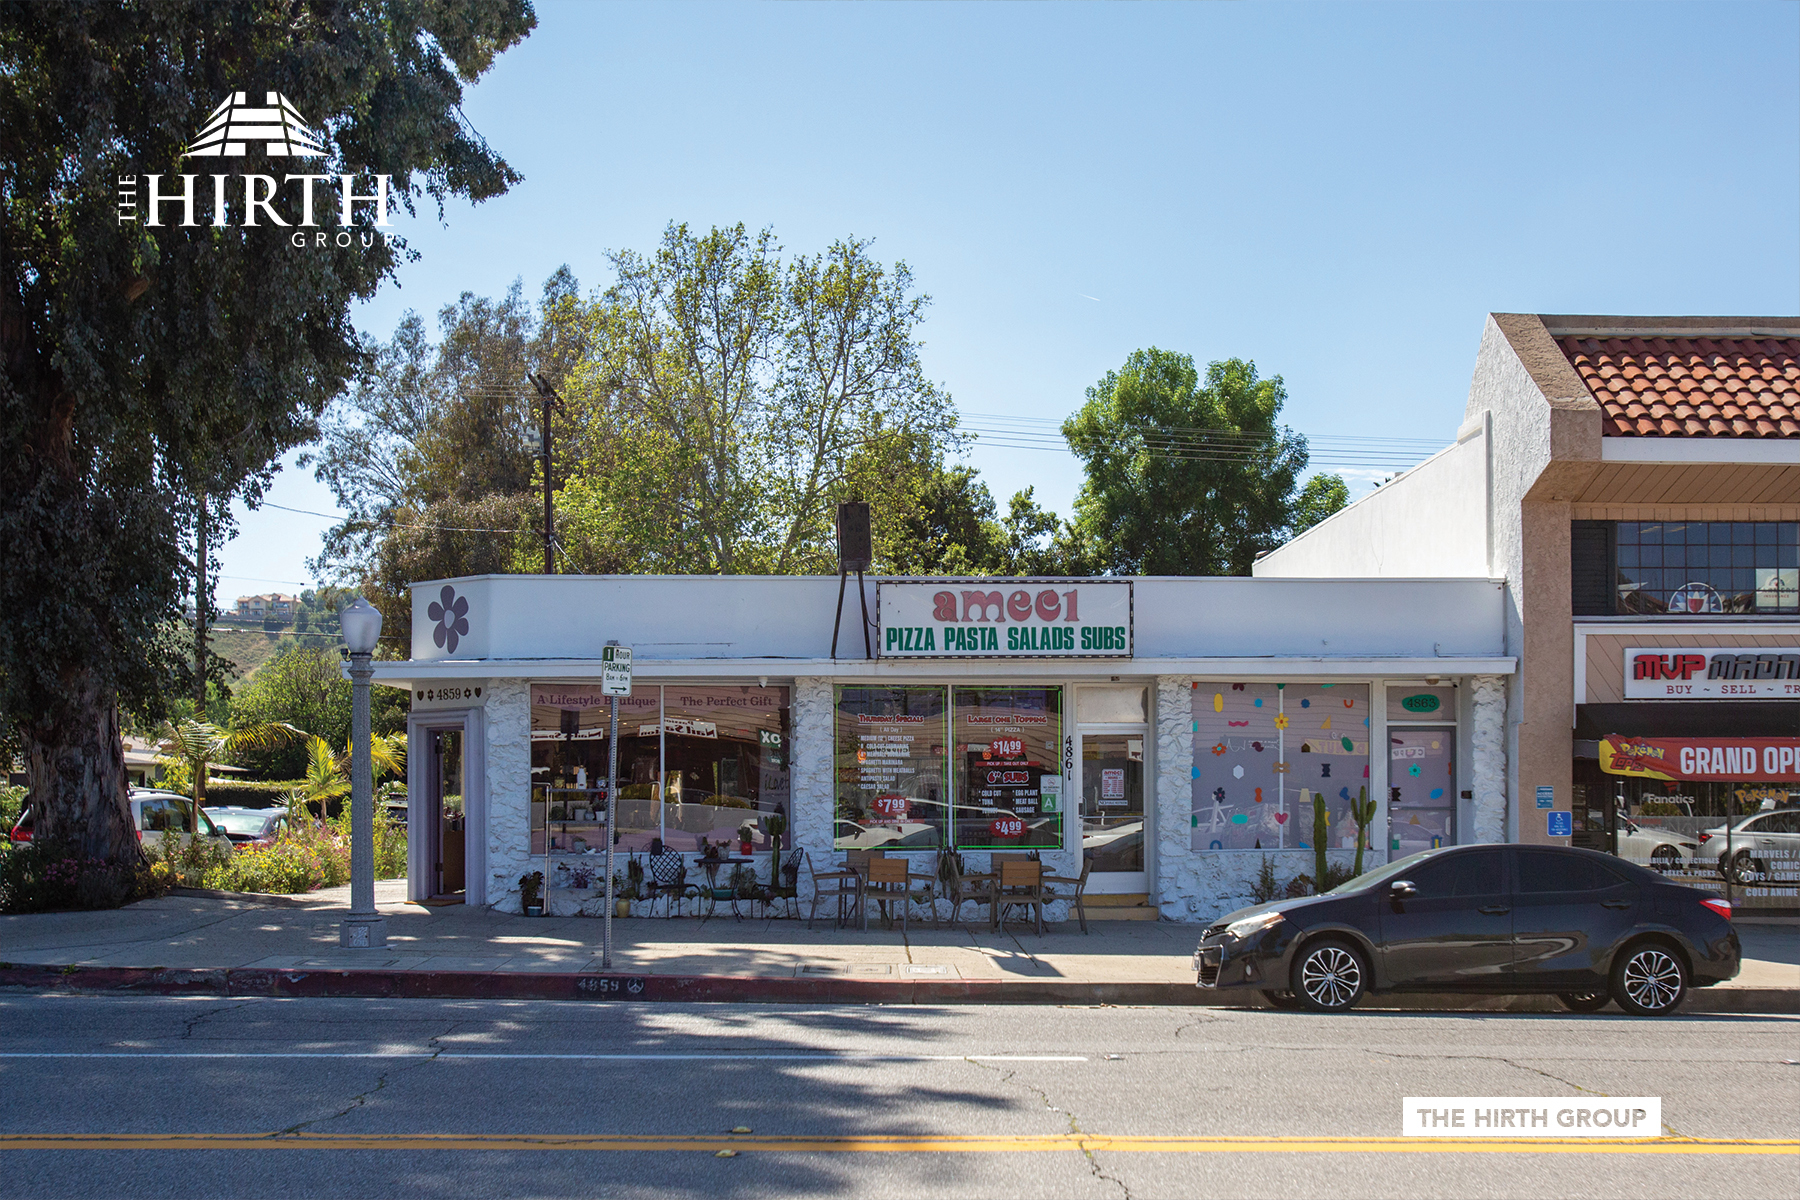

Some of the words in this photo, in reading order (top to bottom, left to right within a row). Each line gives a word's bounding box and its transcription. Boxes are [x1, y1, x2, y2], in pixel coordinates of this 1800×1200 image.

[886, 626, 936, 651] PIZZA
[944, 626, 998, 651] PASTA
[1007, 626, 1074, 651] SALADS
[1080, 626, 1126, 651] SUBS
[615, 650, 630, 660] HOUR
[604, 662, 630, 672] PARKING
[1633, 654, 1706, 680] MVP
[436, 688, 462, 700] 4859
[1666, 685, 1693, 694] BUY
[1721, 685, 1757, 694] SELL
[536, 694, 546, 705] A
[550, 694, 600, 708] Lifestyle
[604, 695, 656, 708] Butique
[680, 696, 704, 706] The
[706, 696, 746, 706] Perfect
[750, 696, 773, 707] Gift
[1406, 698, 1436, 708] 4863
[1680, 747, 1757, 774] GRAND
[1003, 770, 1029, 783] SUBS
[1044, 798, 1053, 808] A
[1648, 793, 1695, 804] Fanatics
[1750, 850, 1790, 858] MARVELS
[1744, 872, 1766, 881] TOYS
[1774, 872, 1800, 881] GAME
[1770, 888, 1798, 896] ANIME
[578, 978, 620, 992] 4859
